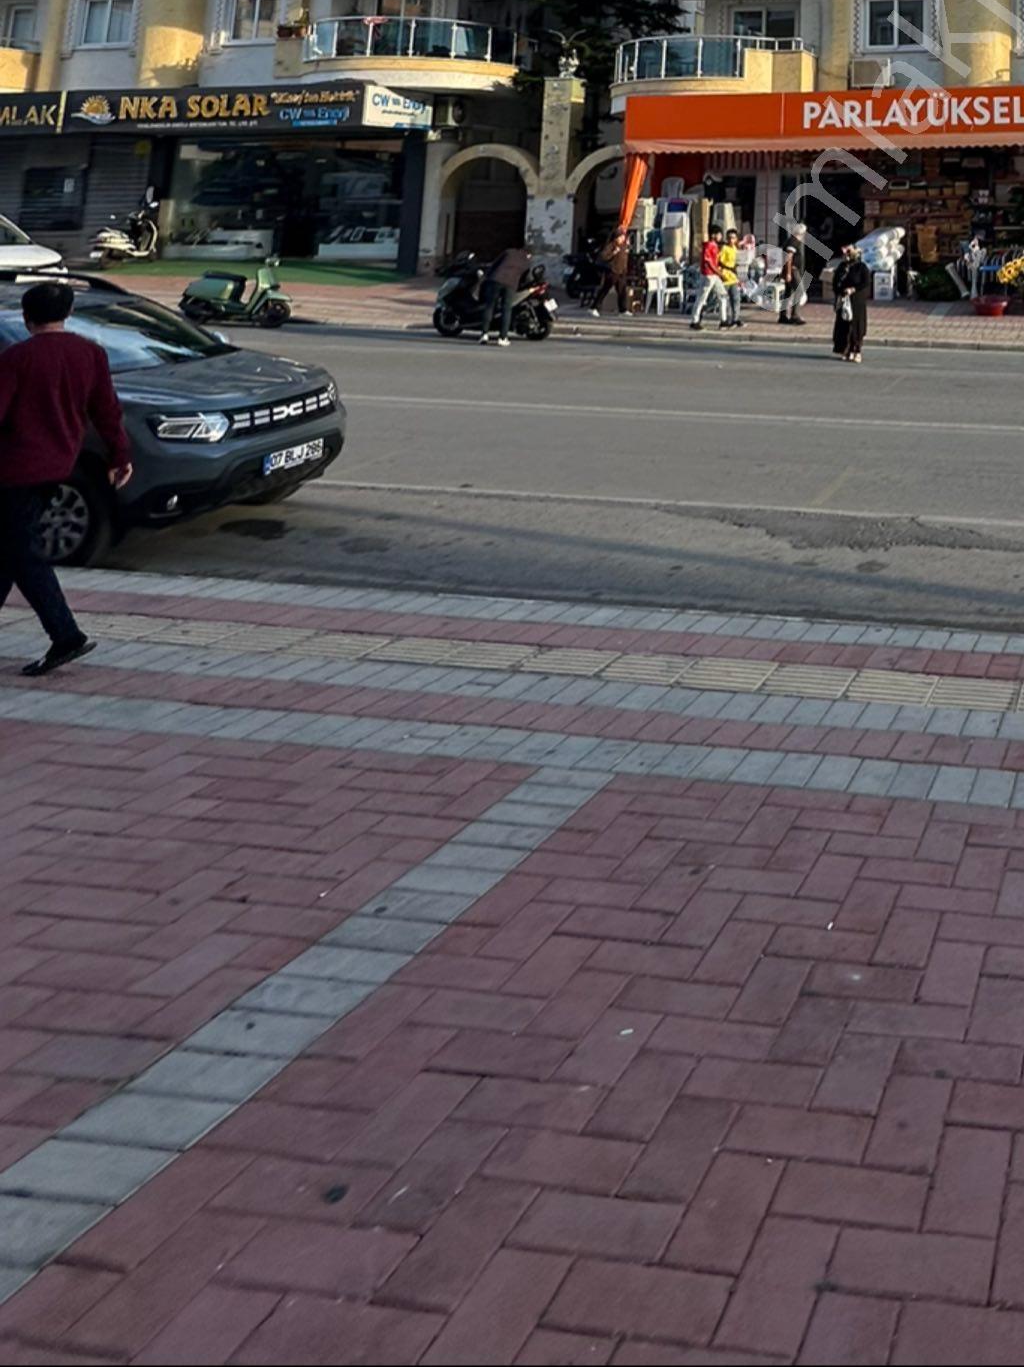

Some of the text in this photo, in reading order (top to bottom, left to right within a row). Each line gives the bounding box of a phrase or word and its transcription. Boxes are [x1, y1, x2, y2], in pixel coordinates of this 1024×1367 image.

[118, 96, 178, 119] NKA
[186, 93, 271, 118] SOLAR
[372, 93, 389, 106] CW
